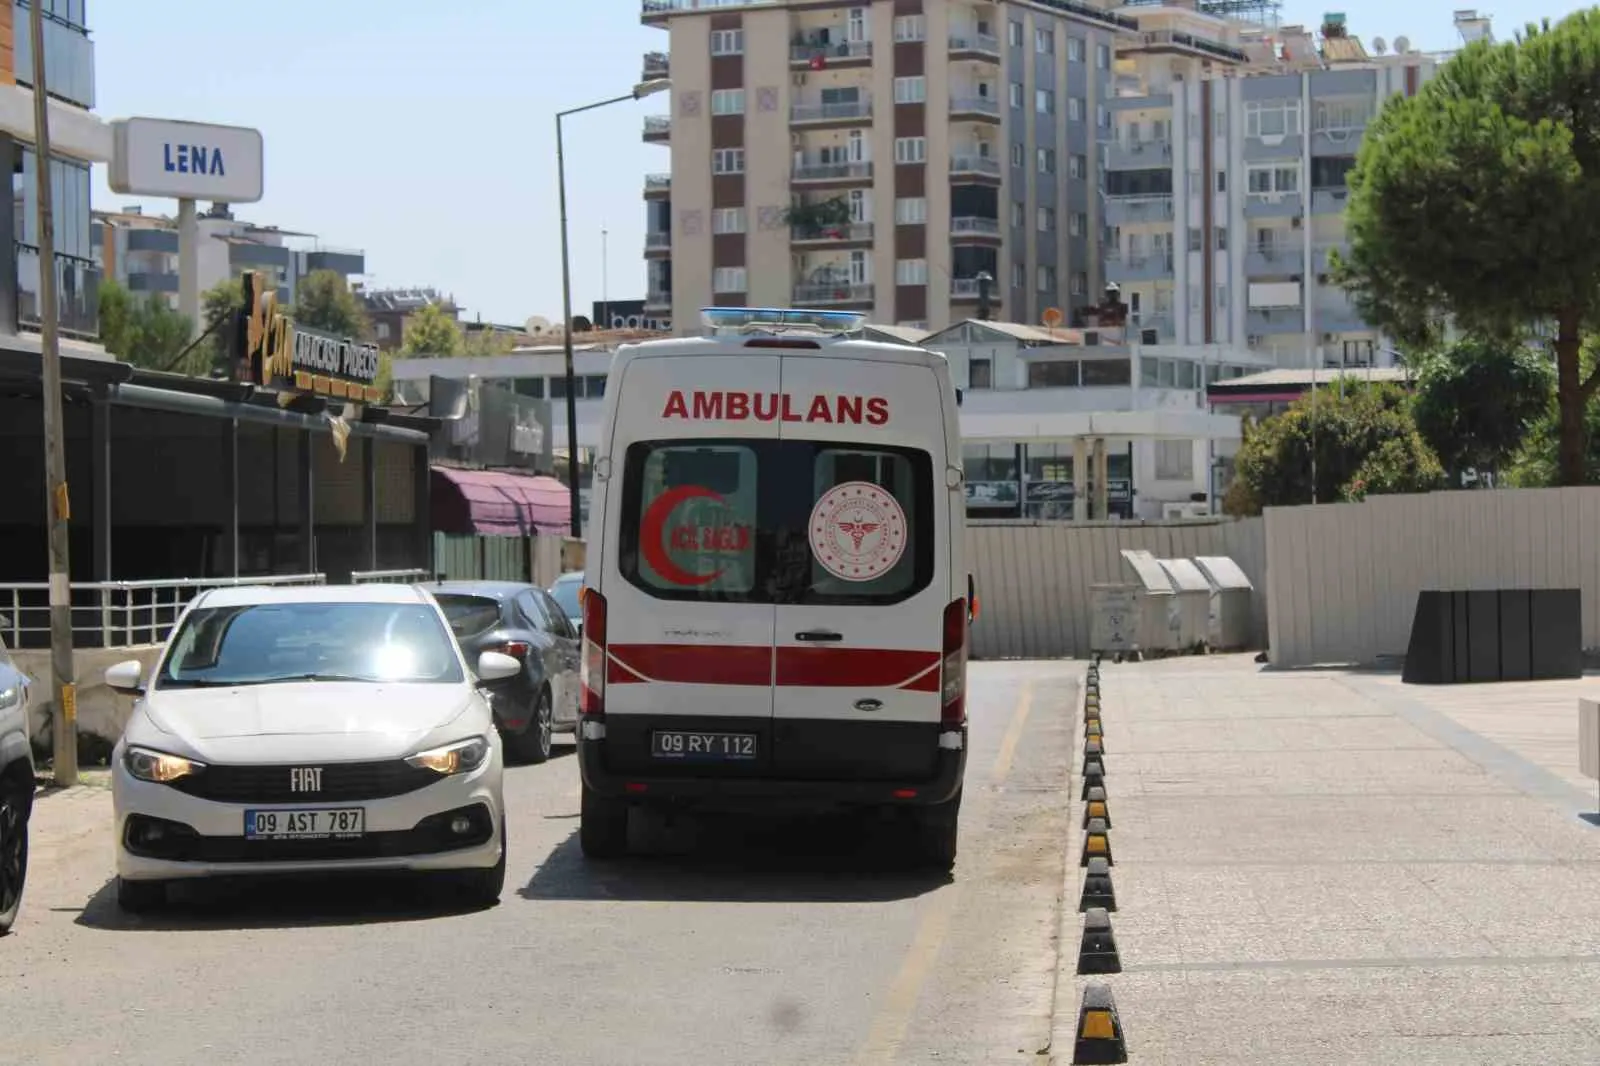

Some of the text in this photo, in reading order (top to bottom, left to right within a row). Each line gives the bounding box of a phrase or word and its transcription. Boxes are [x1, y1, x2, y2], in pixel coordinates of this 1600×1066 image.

[164, 143, 225, 176] LENA
[661, 390, 890, 425] AMBULANS
[661, 734, 753, 754] 09 RY 112
[290, 767, 323, 792] FIAT
[256, 814, 277, 832] 09
[287, 812, 319, 831] AST
[328, 811, 358, 830] 787
